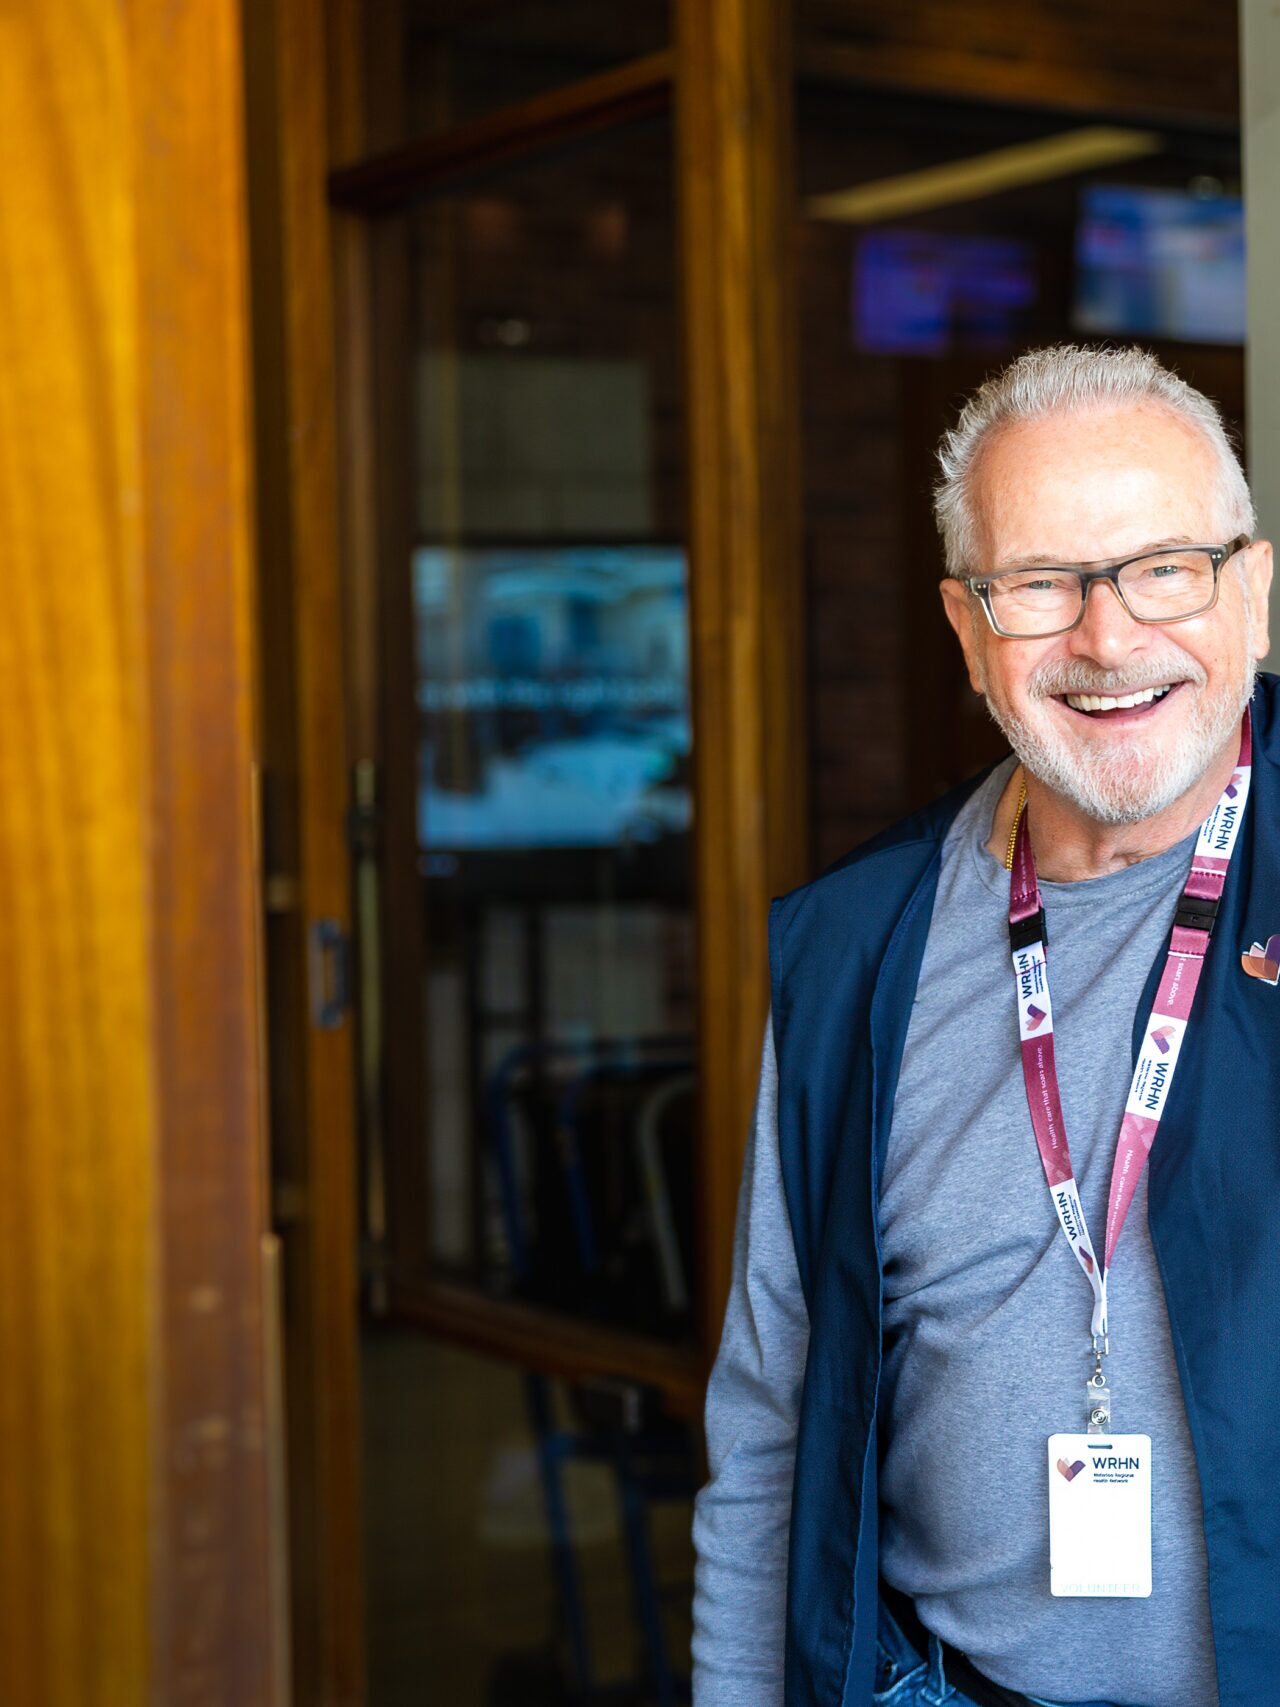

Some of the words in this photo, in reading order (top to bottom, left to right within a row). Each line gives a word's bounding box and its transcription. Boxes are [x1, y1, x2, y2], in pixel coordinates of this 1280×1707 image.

[1214, 805, 1238, 850] WRHN
[1017, 953, 1033, 1000] WRHN
[1145, 1062, 1169, 1110] WRHN
[1057, 1191, 1077, 1241] WRHN
[1092, 1457, 1139, 1470] WRHN
